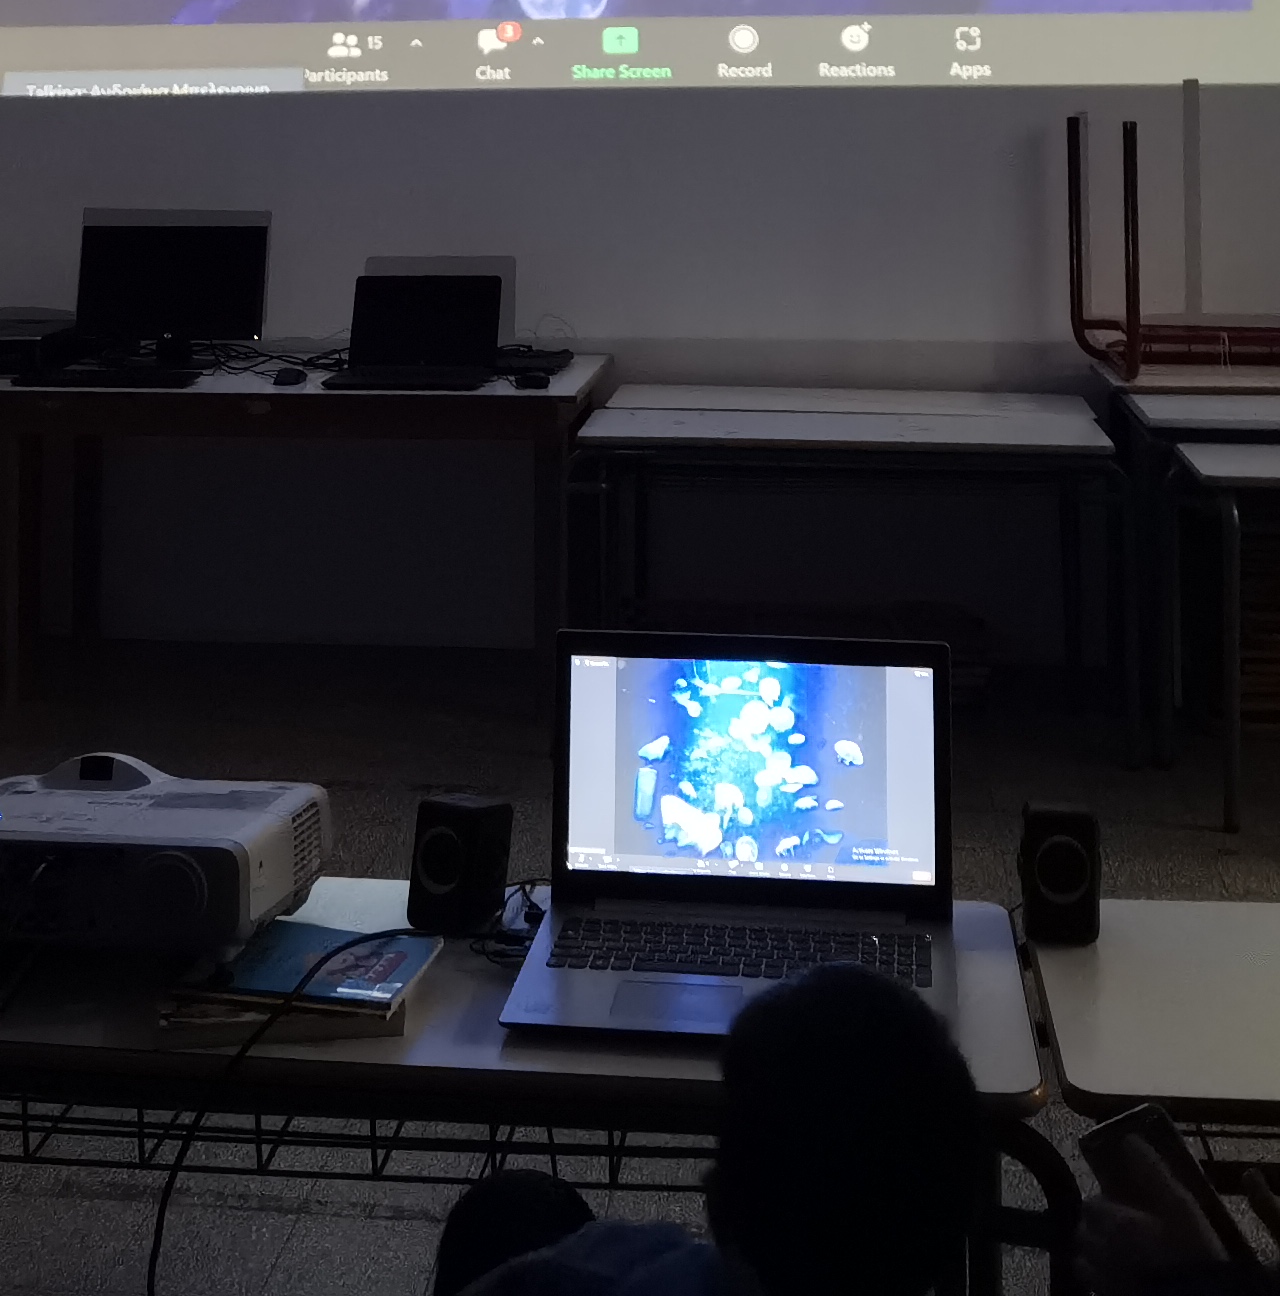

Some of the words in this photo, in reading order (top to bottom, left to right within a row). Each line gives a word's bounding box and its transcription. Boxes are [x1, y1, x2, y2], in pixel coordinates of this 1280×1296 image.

[367, 35, 383, 50] 15
[475, 64, 512, 81] Chat
[572, 64, 616, 79] Share
[618, 64, 673, 79] Screen
[718, 62, 773, 78] Record
[818, 62, 896, 78] Reactions
[950, 61, 992, 80] Apps
